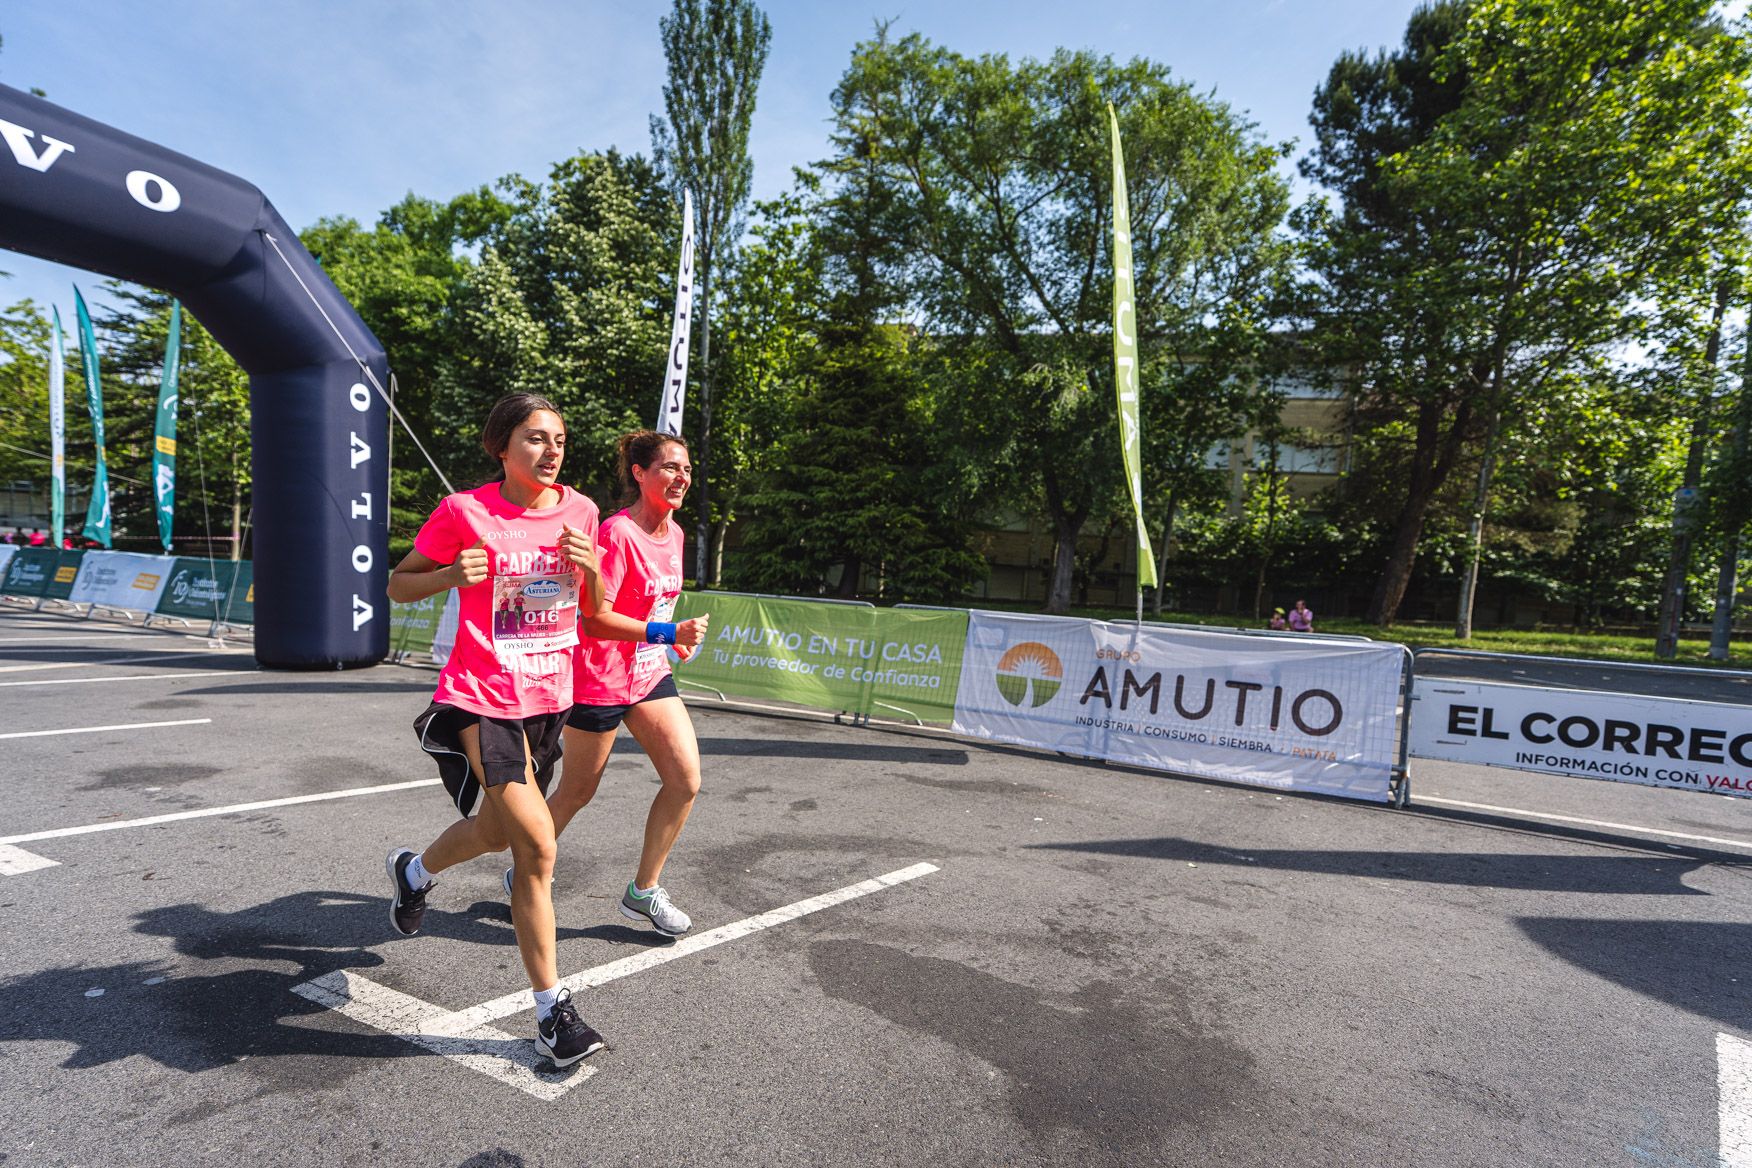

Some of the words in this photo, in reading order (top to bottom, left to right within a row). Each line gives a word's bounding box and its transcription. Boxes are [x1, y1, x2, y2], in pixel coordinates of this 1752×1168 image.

[349, 382, 374, 632] VOLVO
[487, 530, 527, 540] OYSHO
[524, 610, 559, 624] 016
[717, 624, 802, 651] AMUTIO
[808, 635, 837, 657] EN
[845, 637, 875, 659] TU
[882, 641, 942, 664] CASA
[1096, 648, 1141, 662] GRUPO
[713, 648, 729, 664] Tu
[731, 652, 820, 674] proveedor
[823, 663, 846, 679] de
[850, 666, 941, 689] Confianza
[1079, 665, 1342, 736] AMUTIO
[1075, 716, 1134, 733] INDUSTRIA
[1144, 726, 1207, 743] CONSUMO
[1218, 736, 1273, 753] SIEMBRA
[1448, 704, 1510, 740] EL
[1515, 752, 1648, 778] INFORMACIÓN
[1655, 769, 1699, 785] CON
